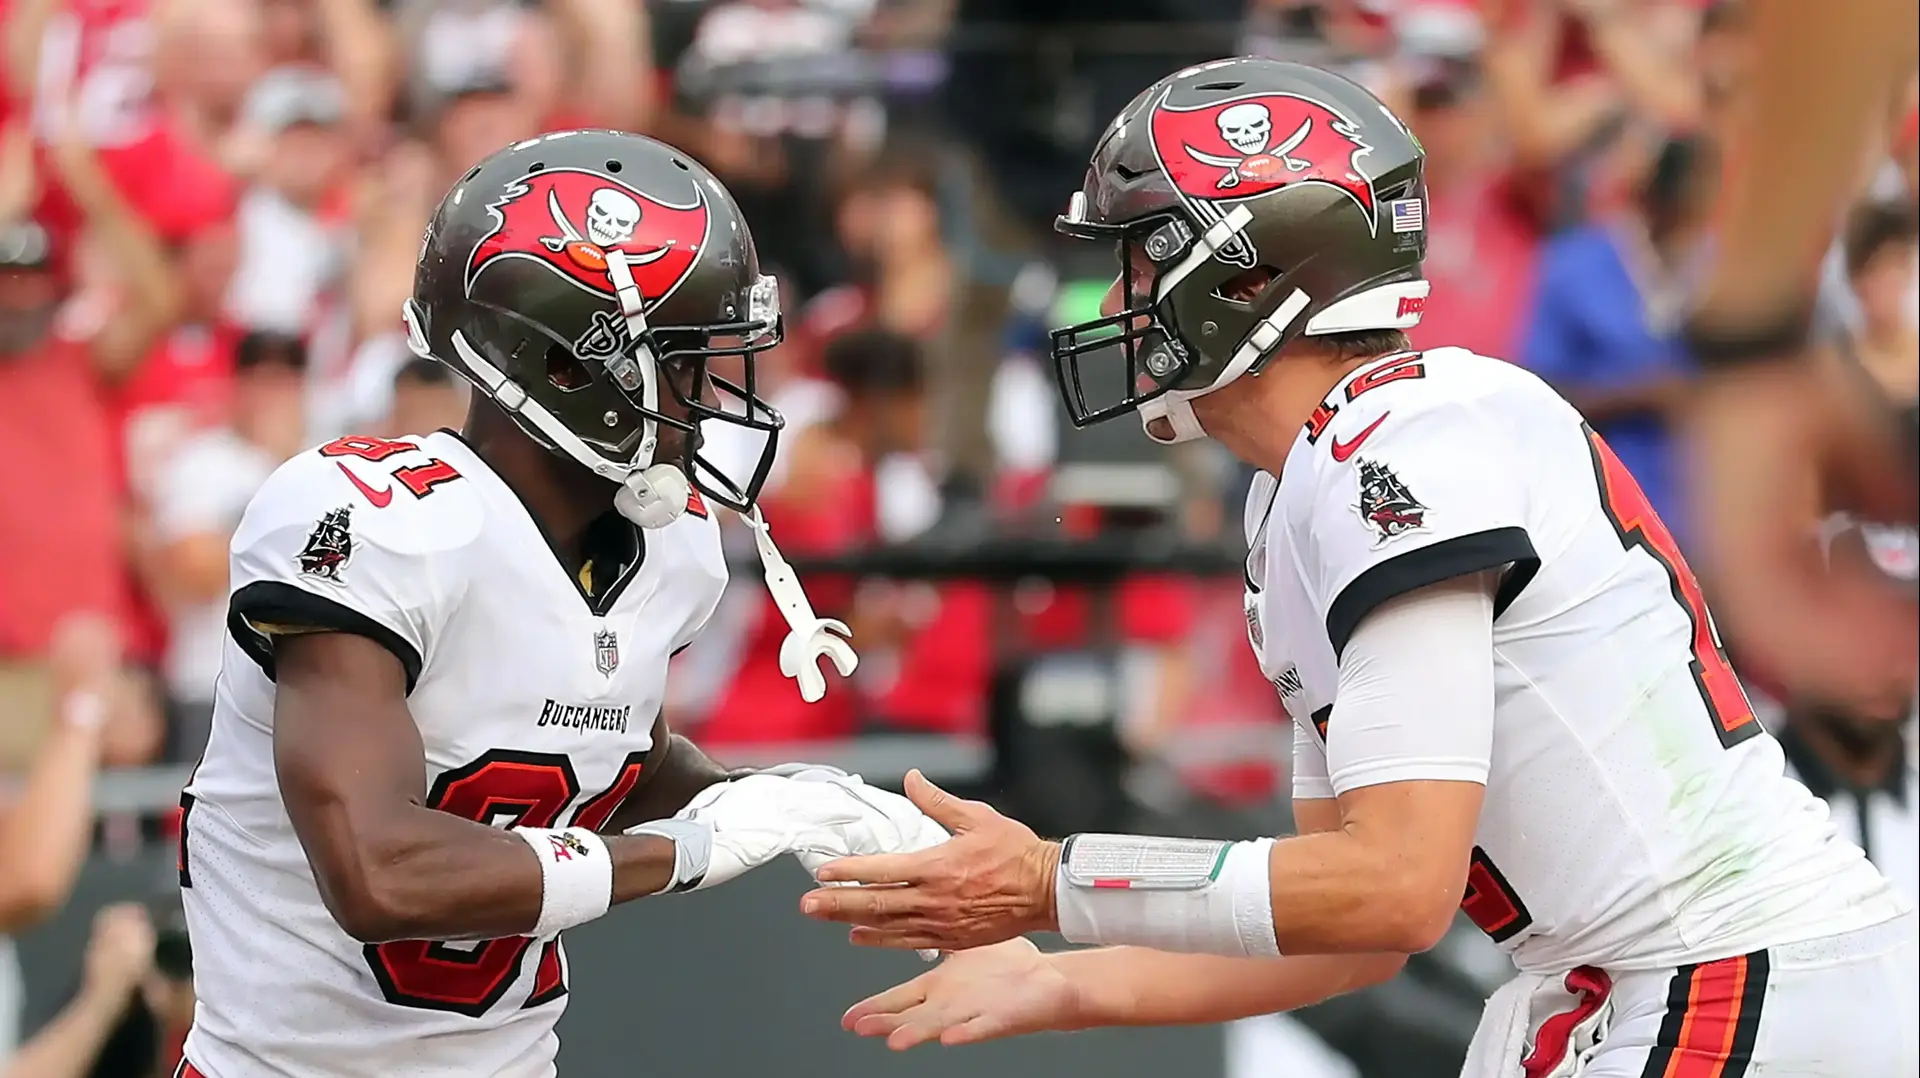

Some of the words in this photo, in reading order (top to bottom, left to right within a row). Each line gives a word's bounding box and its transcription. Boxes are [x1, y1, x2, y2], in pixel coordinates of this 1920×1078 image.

[1305, 351, 1426, 447] 12
[318, 434, 464, 500] 81
[537, 698, 631, 735] BUCCANEERS
